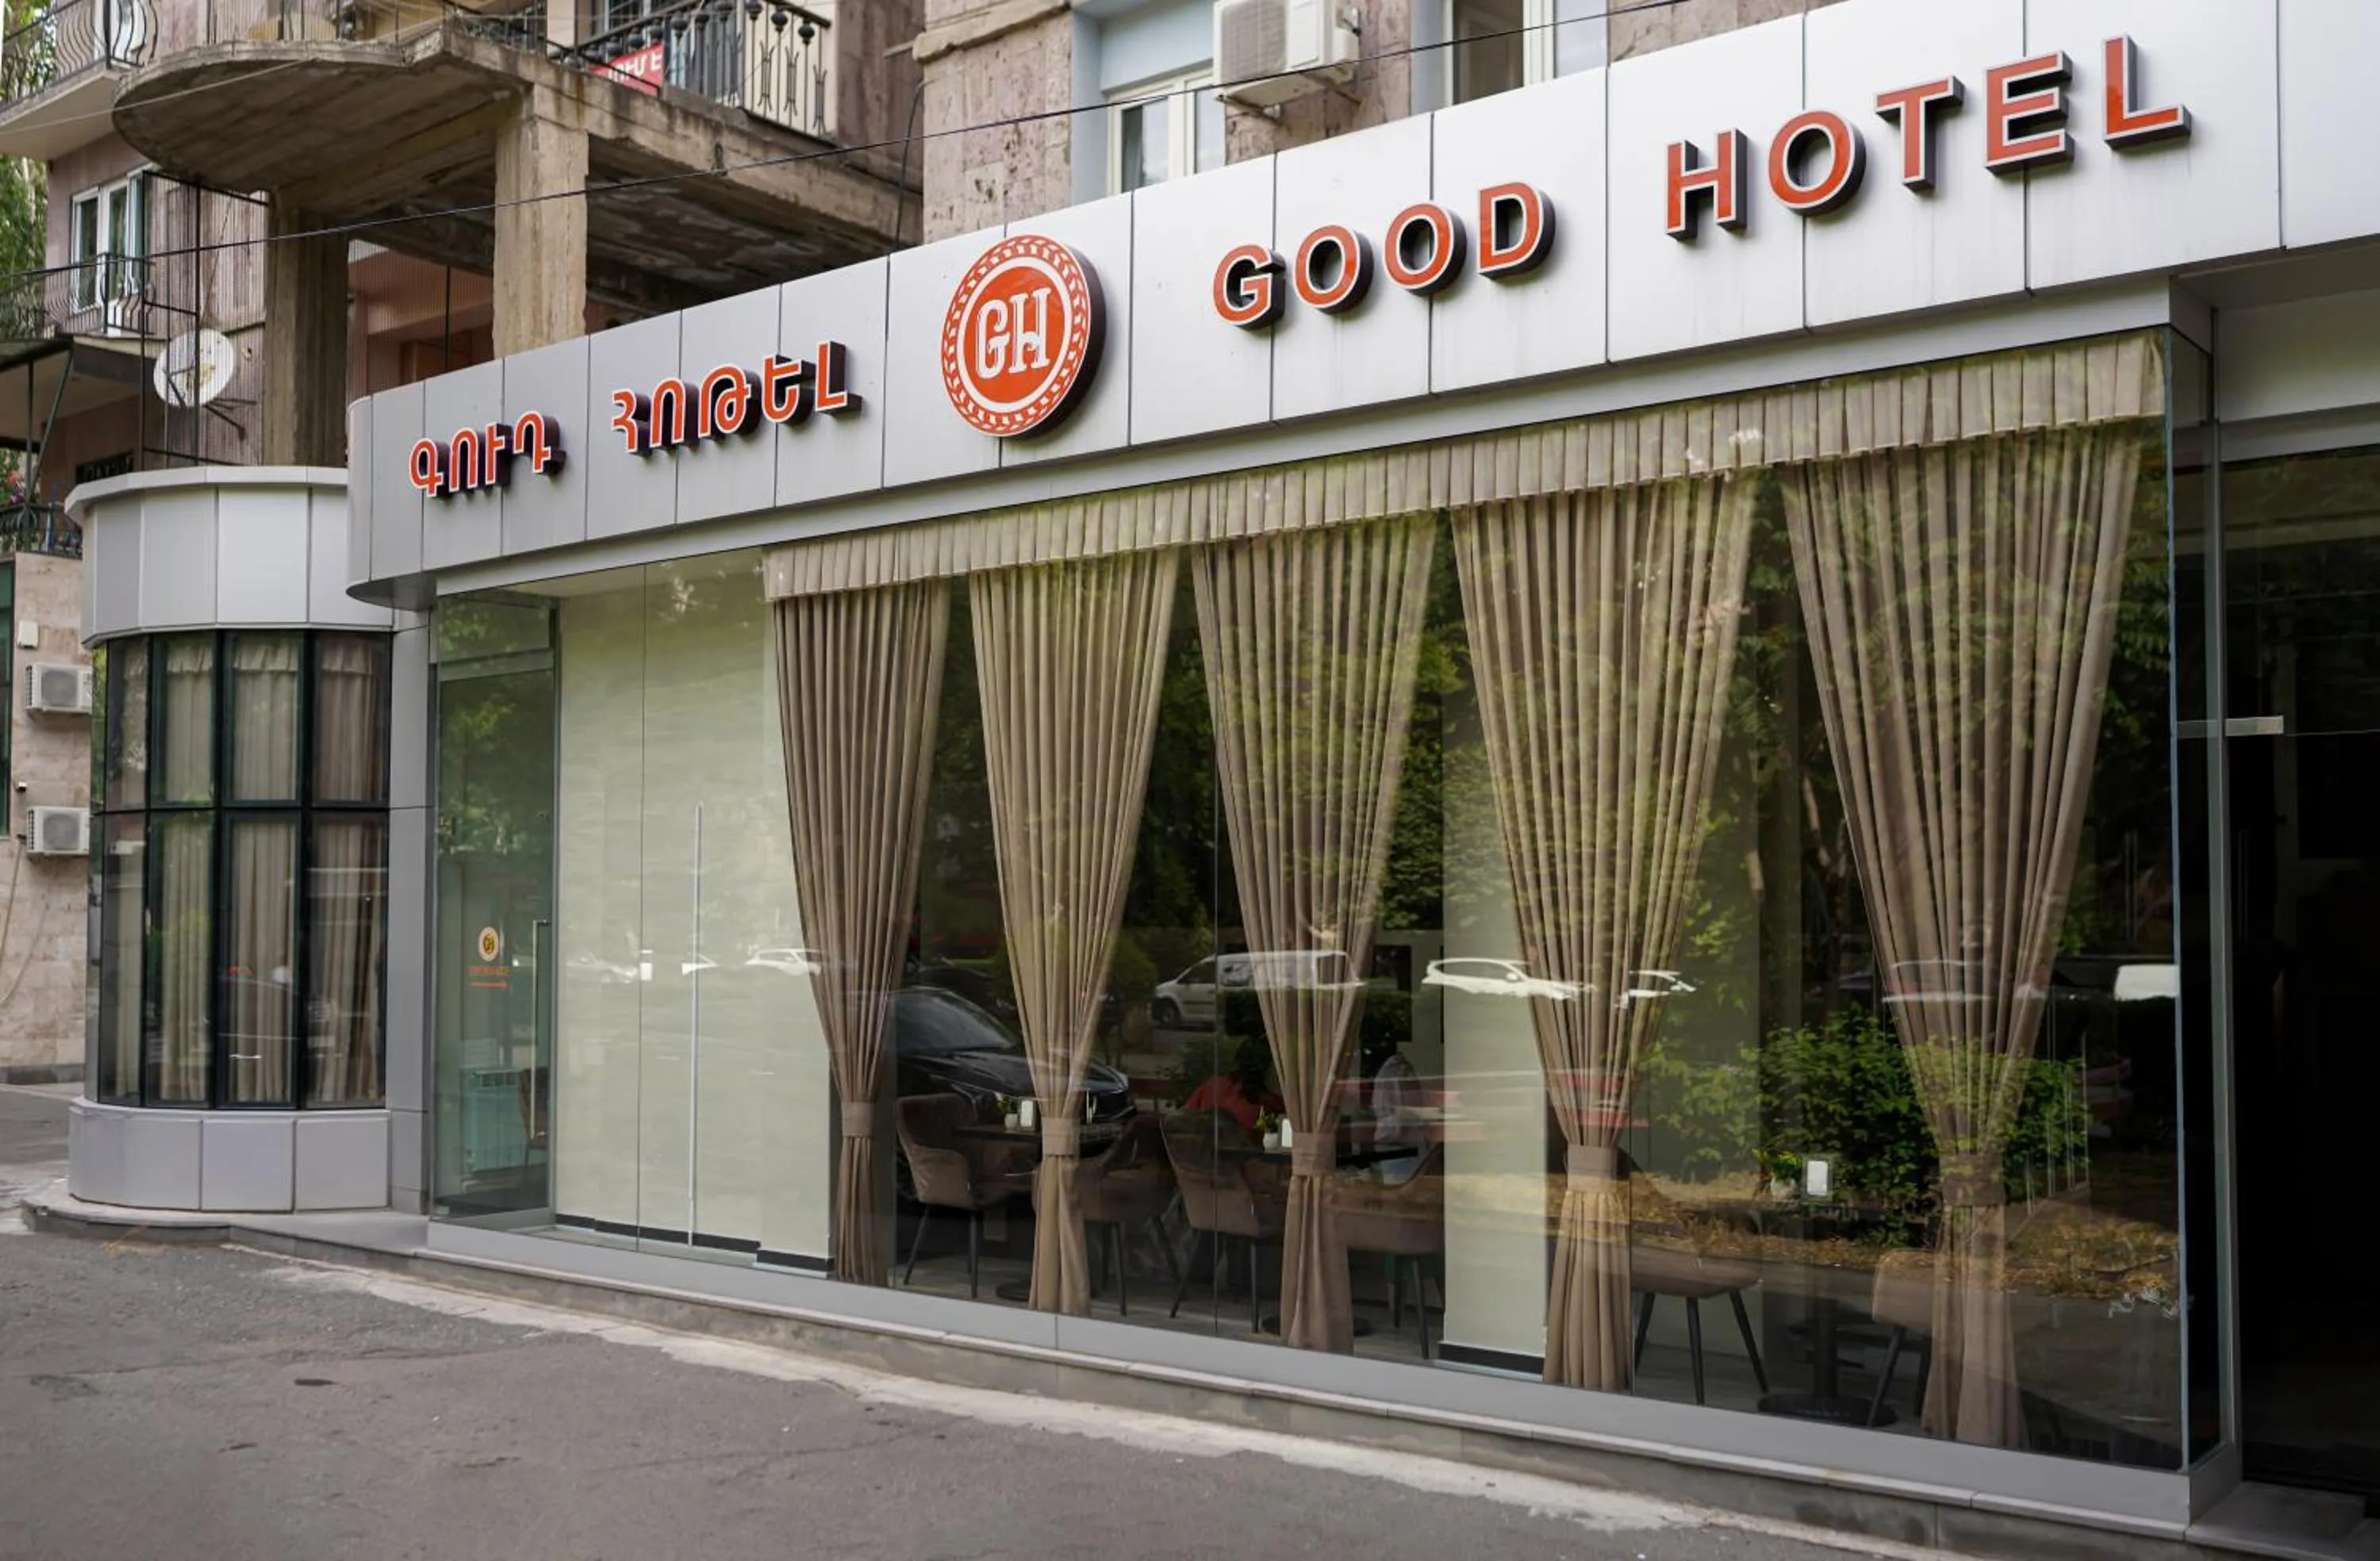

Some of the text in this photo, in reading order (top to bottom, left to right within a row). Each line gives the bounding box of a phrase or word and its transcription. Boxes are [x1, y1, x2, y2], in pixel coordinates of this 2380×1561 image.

[1212, 33, 2190, 328] GOOD HOTEL
[976, 286, 1052, 380] GH
[409, 341, 850, 497] ԳՈՒԴ ՀՈԹԵԼ
